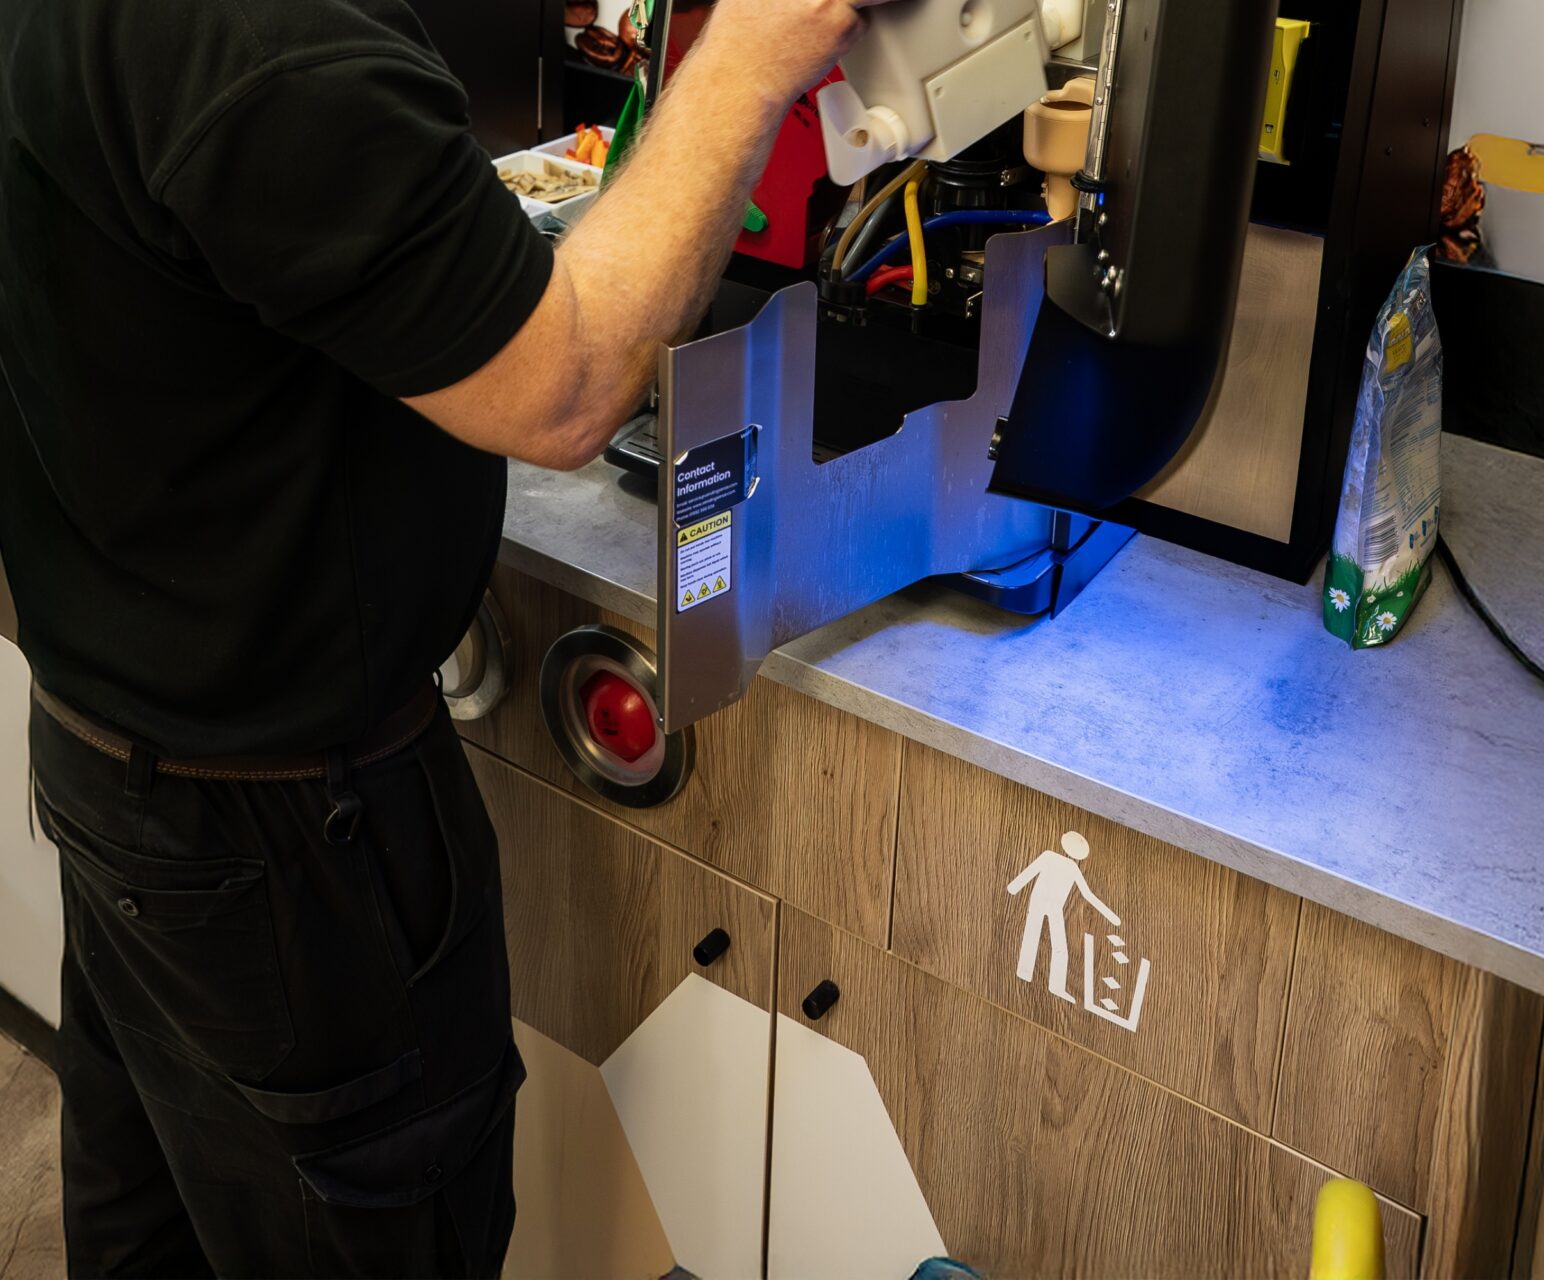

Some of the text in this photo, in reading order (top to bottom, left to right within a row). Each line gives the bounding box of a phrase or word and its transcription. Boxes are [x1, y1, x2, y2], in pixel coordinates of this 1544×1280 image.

[677, 461, 715, 483] Contact
[677, 469, 731, 497] Information
[689, 515, 729, 538] CAUTION
